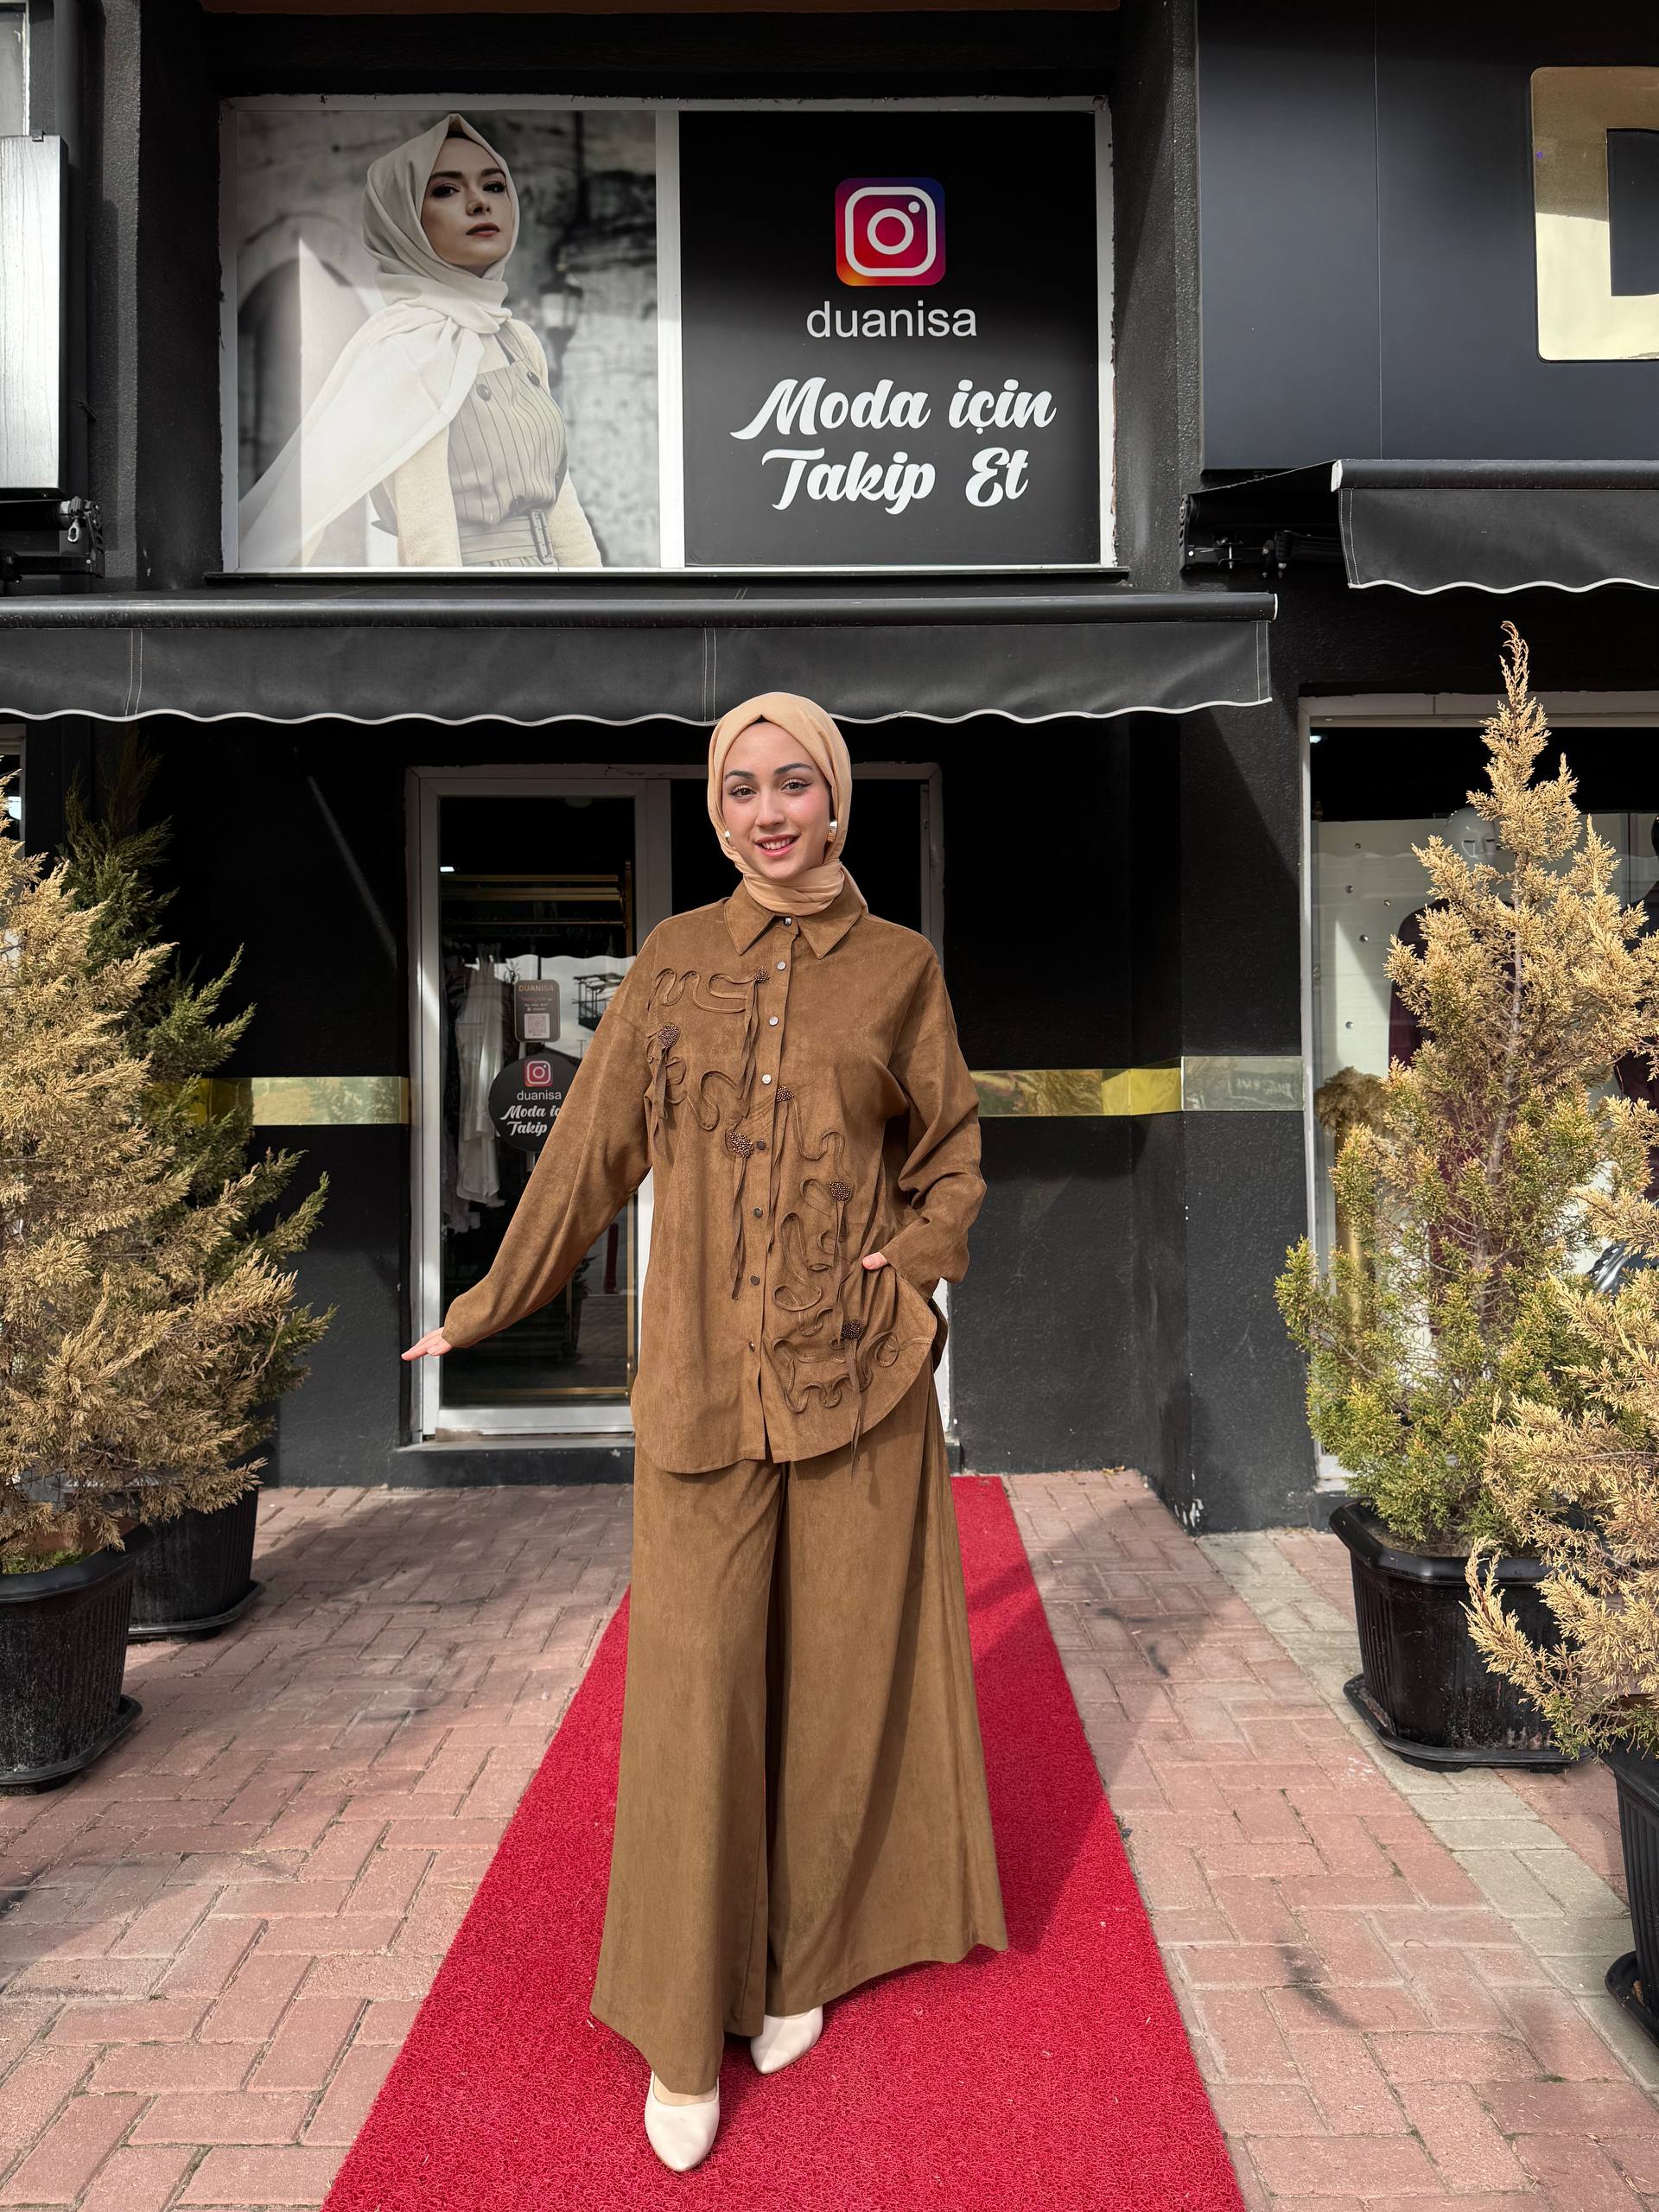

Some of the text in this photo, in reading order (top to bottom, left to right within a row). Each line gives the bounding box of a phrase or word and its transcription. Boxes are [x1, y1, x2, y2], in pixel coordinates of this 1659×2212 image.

[806, 300, 977, 337] duanisa
[729, 377, 1057, 440] Moda için
[761, 447, 1029, 515] Takip Et
[517, 1090, 562, 1101] duanisa
[499, 1105, 547, 1121] Moda
[506, 1121, 548, 1137] Takip
